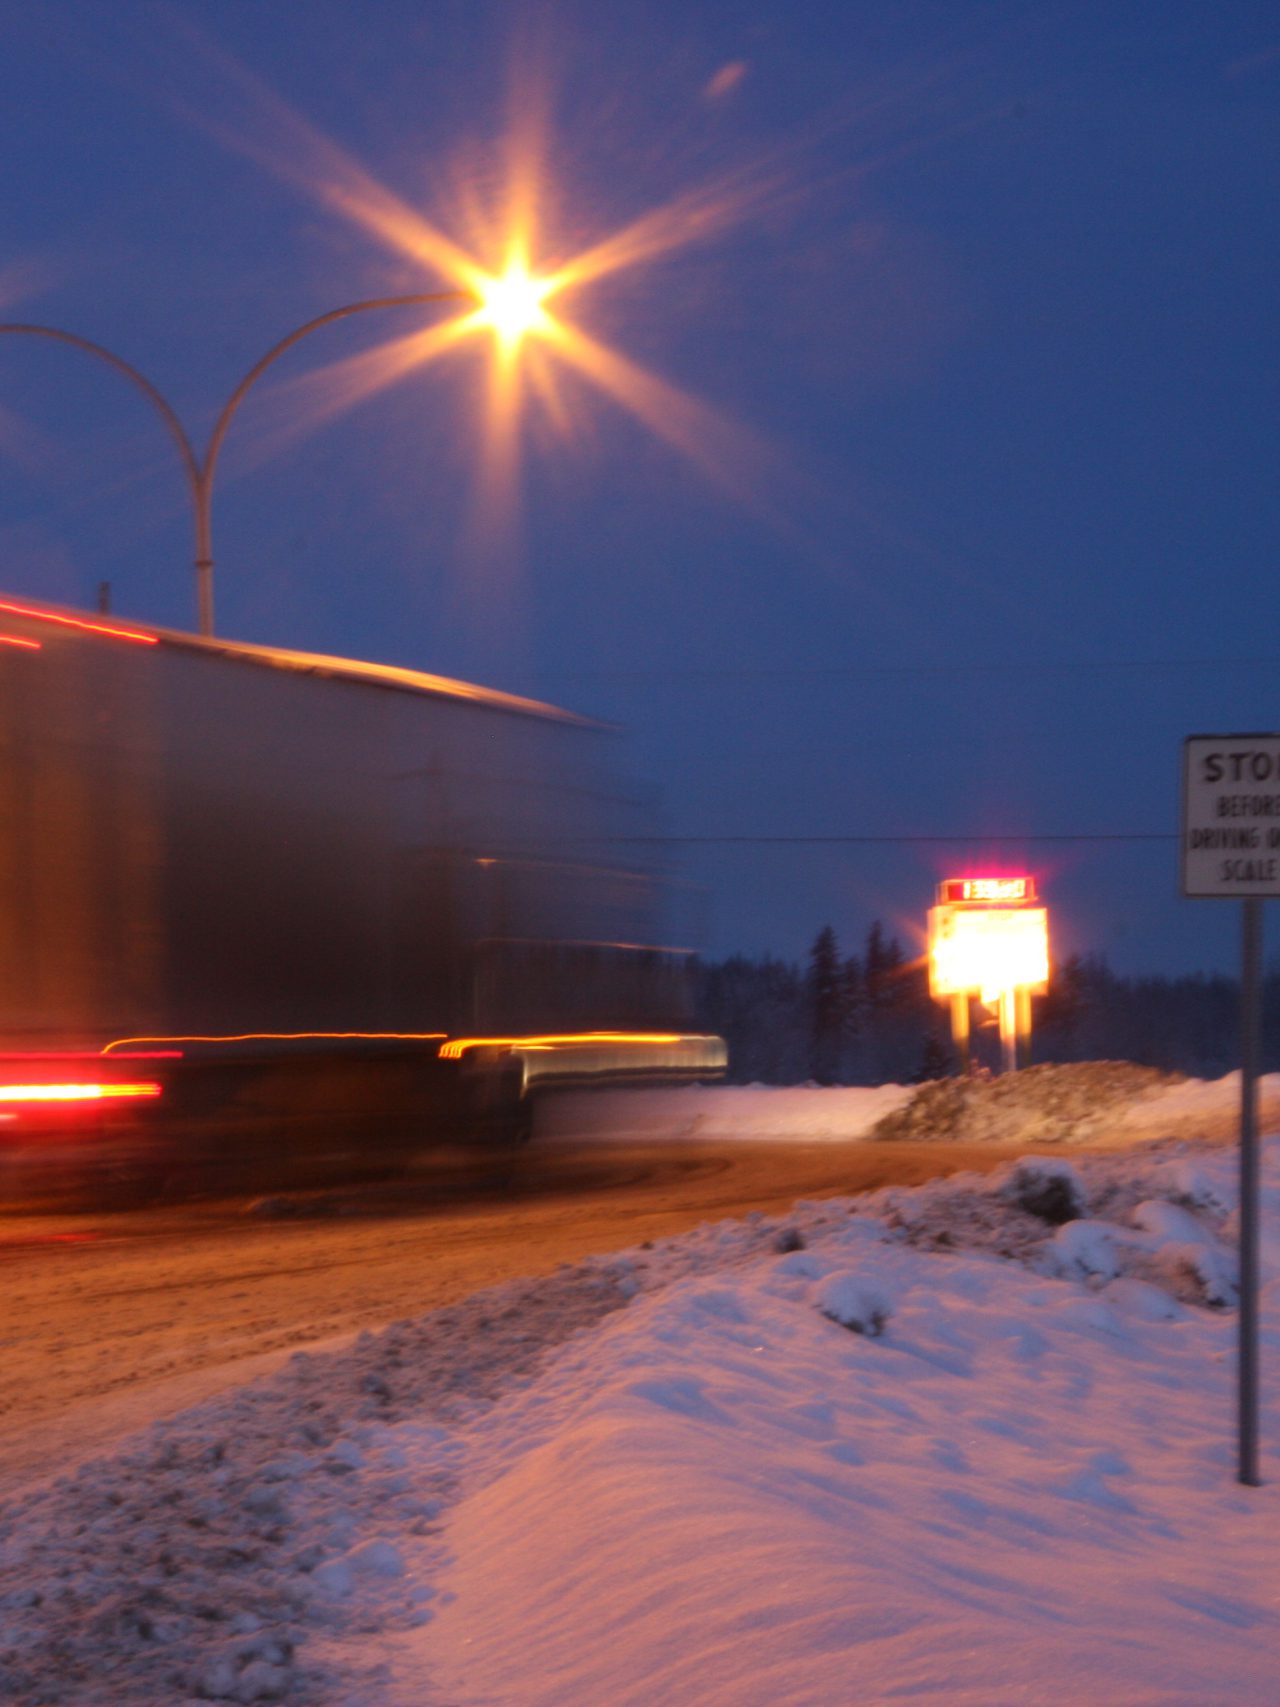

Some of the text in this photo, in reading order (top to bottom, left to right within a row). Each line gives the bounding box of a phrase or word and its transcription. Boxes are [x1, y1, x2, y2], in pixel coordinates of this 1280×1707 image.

[1204, 752, 1280, 782] STO
[1191, 828, 1260, 849] DRIVING
[1221, 859, 1277, 881] SCALE
